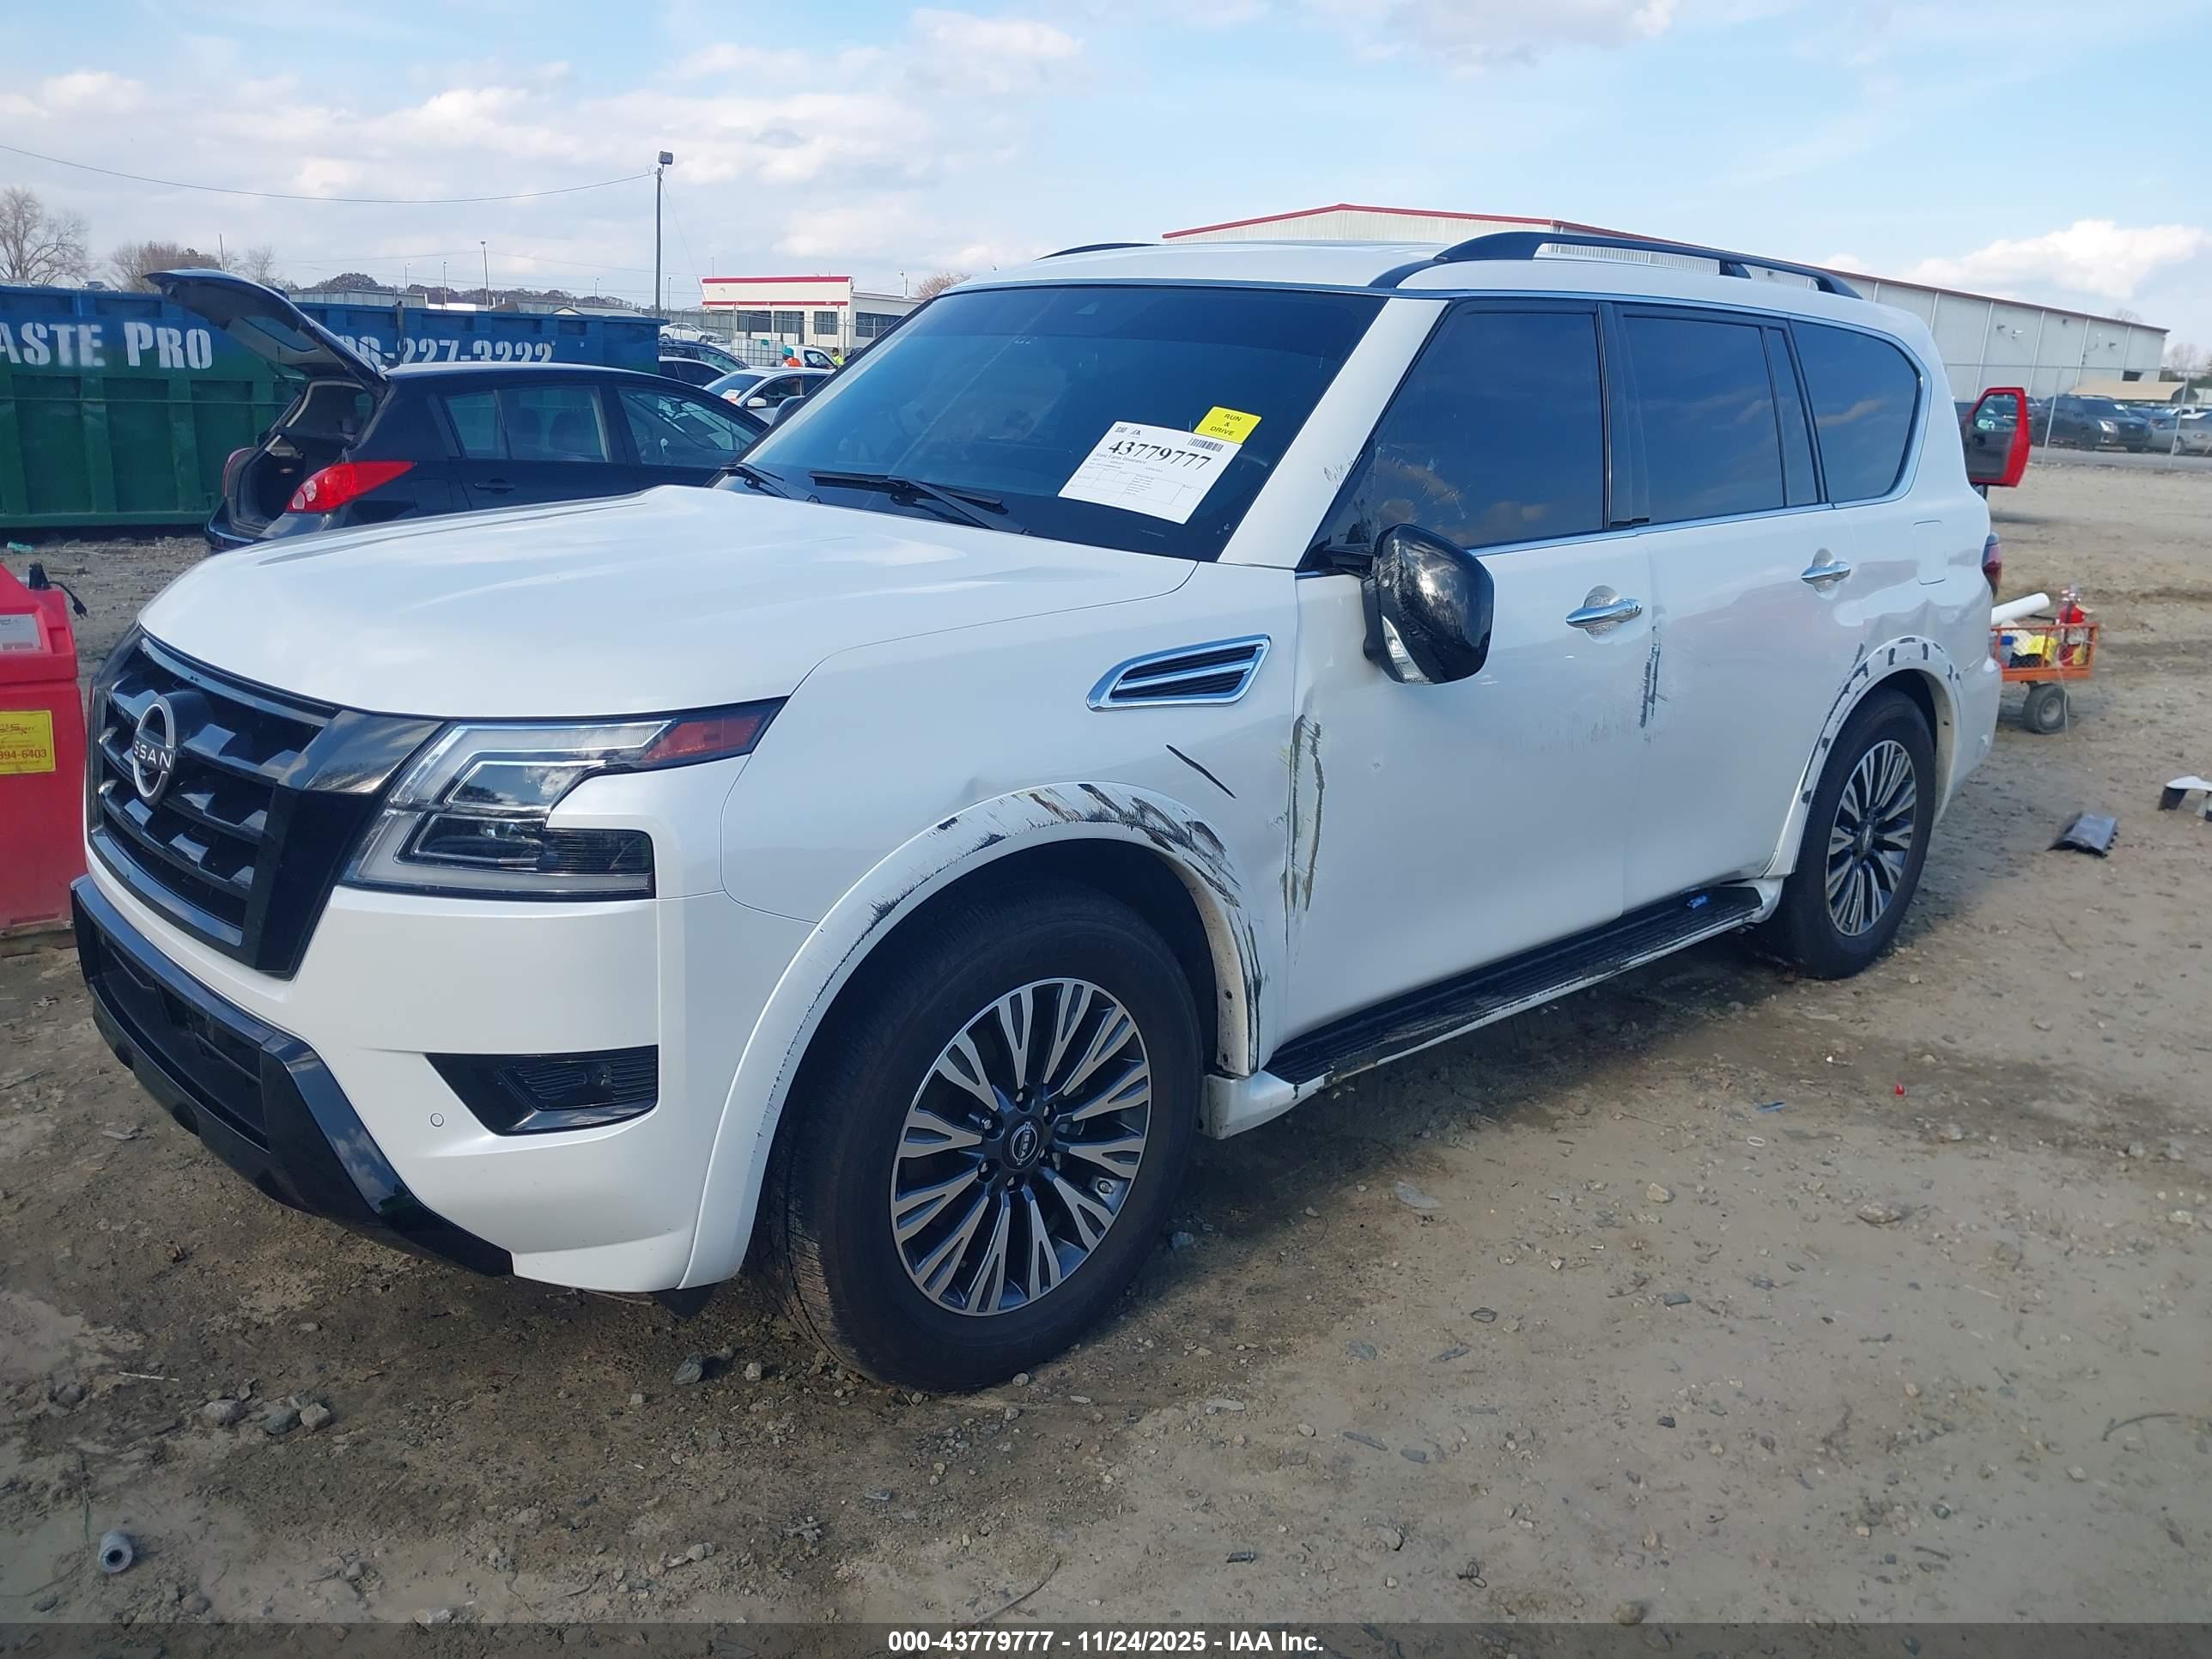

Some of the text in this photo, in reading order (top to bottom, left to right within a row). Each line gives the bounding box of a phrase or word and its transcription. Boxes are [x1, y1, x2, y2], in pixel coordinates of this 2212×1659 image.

[124, 322, 213, 369] PRO
[1210, 426, 1235, 436] DRIVE
[1224, 413, 1242, 422] RUN
[1108, 440, 1212, 471] 43779777
[134, 739, 173, 769] SSAN
[1017, 1120, 1031, 1166] NISSAN
